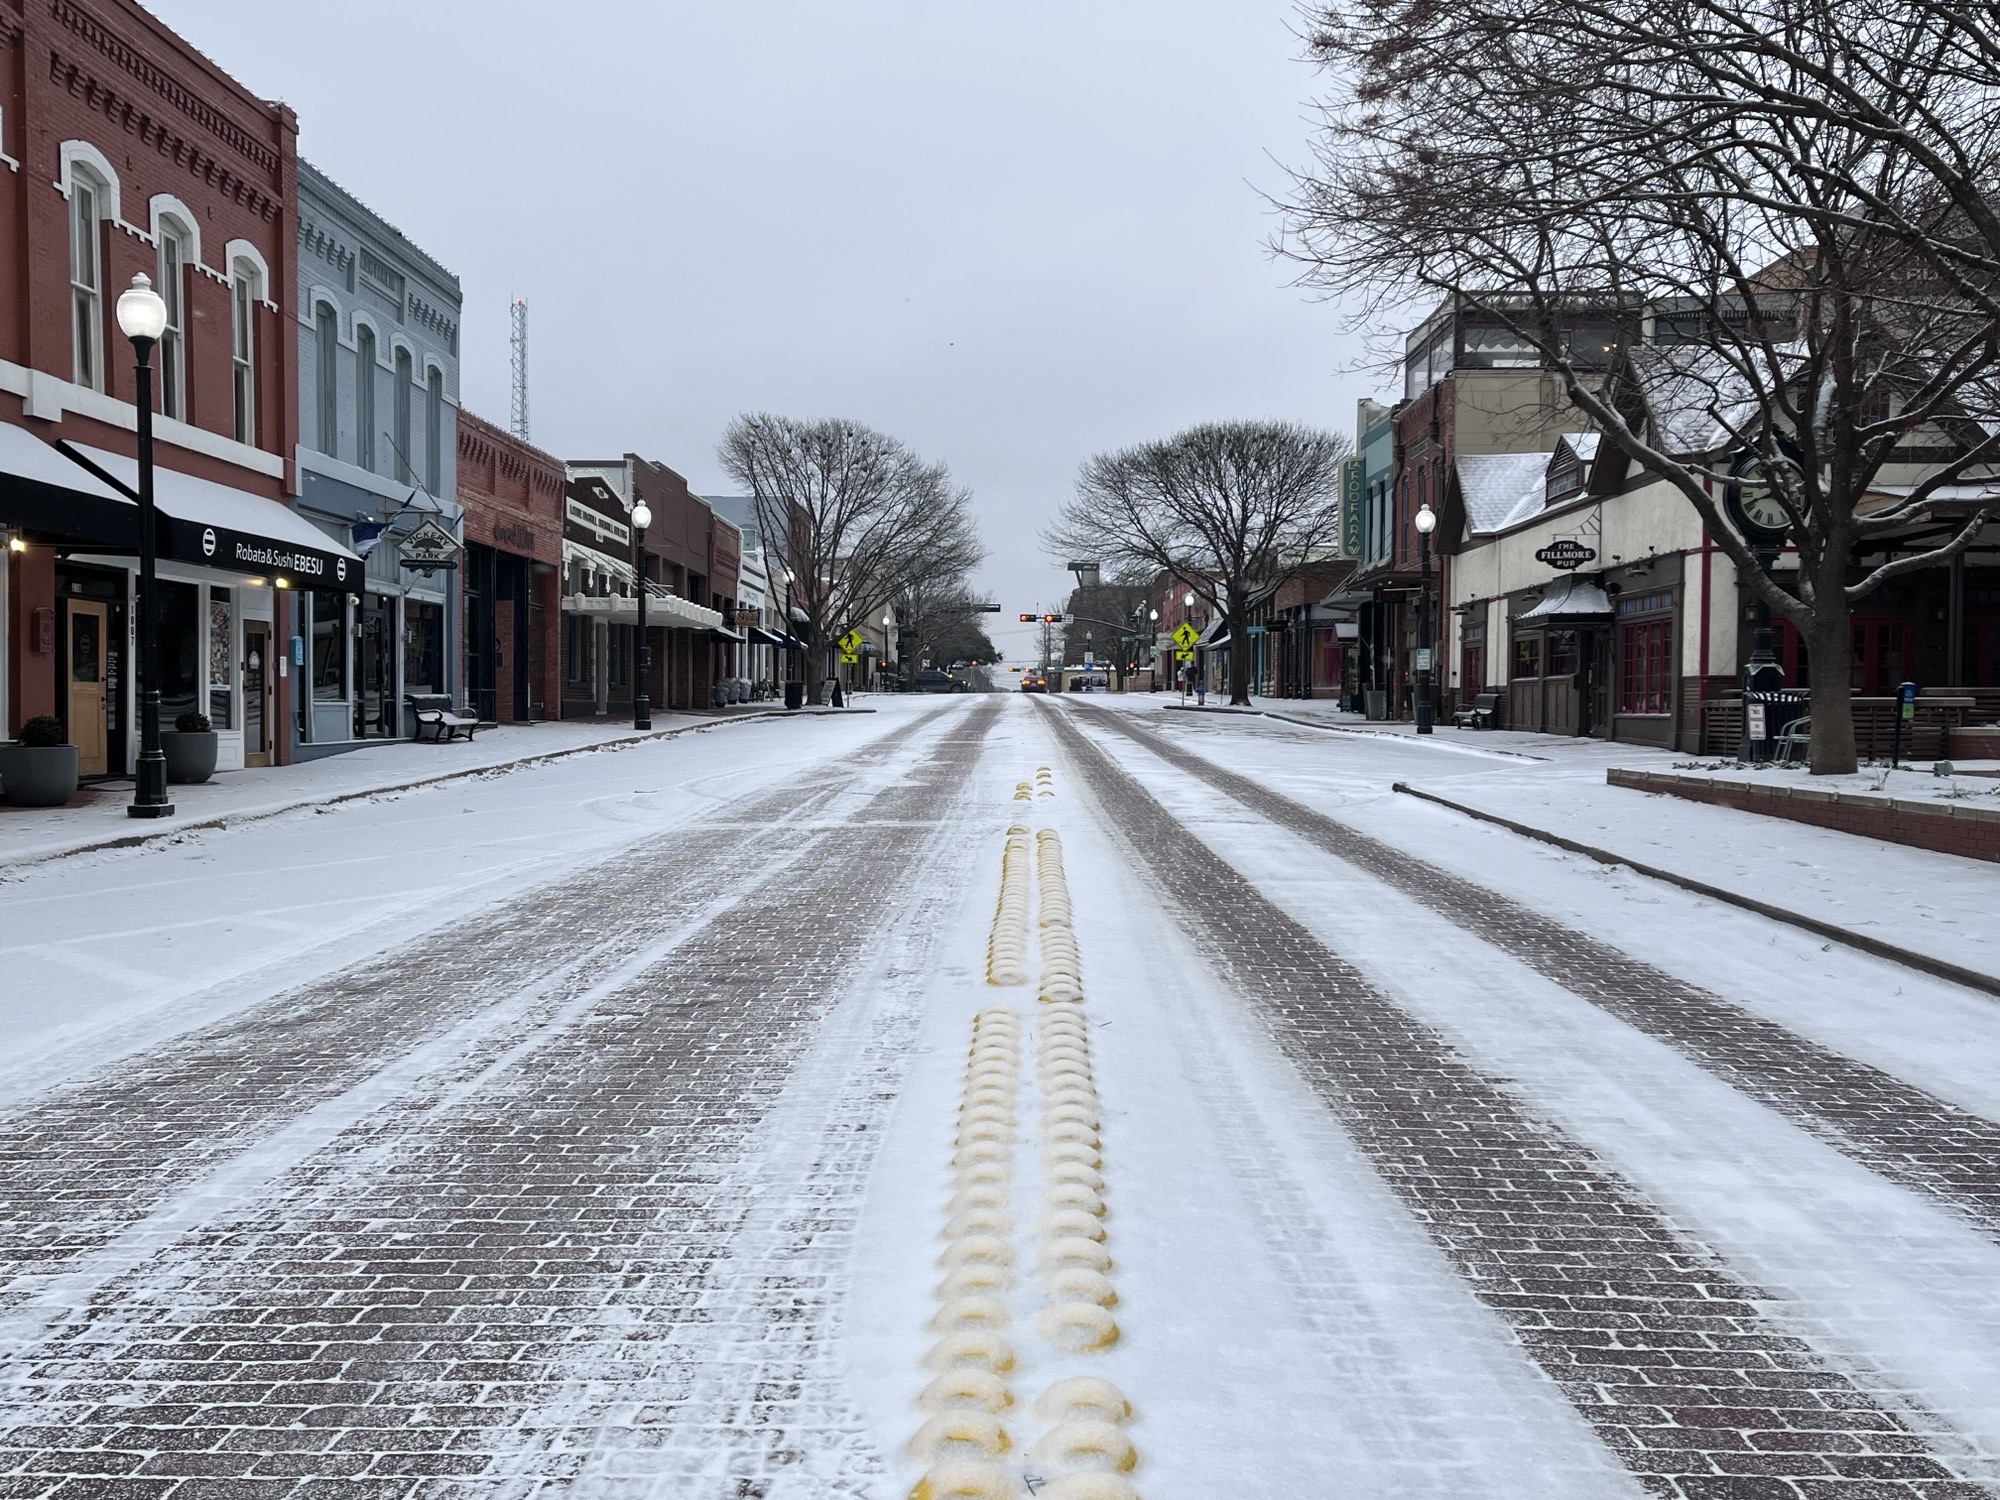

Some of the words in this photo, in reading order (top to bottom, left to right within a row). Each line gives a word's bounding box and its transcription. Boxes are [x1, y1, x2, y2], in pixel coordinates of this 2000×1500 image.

[1347, 461, 1361, 470] LA
[1348, 470, 1361, 556] FOOFARAW
[406, 531, 450, 546] VICKERY
[415, 552, 440, 560] PARK
[1541, 551, 1592, 559] FILLMORE
[293, 553, 323, 575] EBESU
